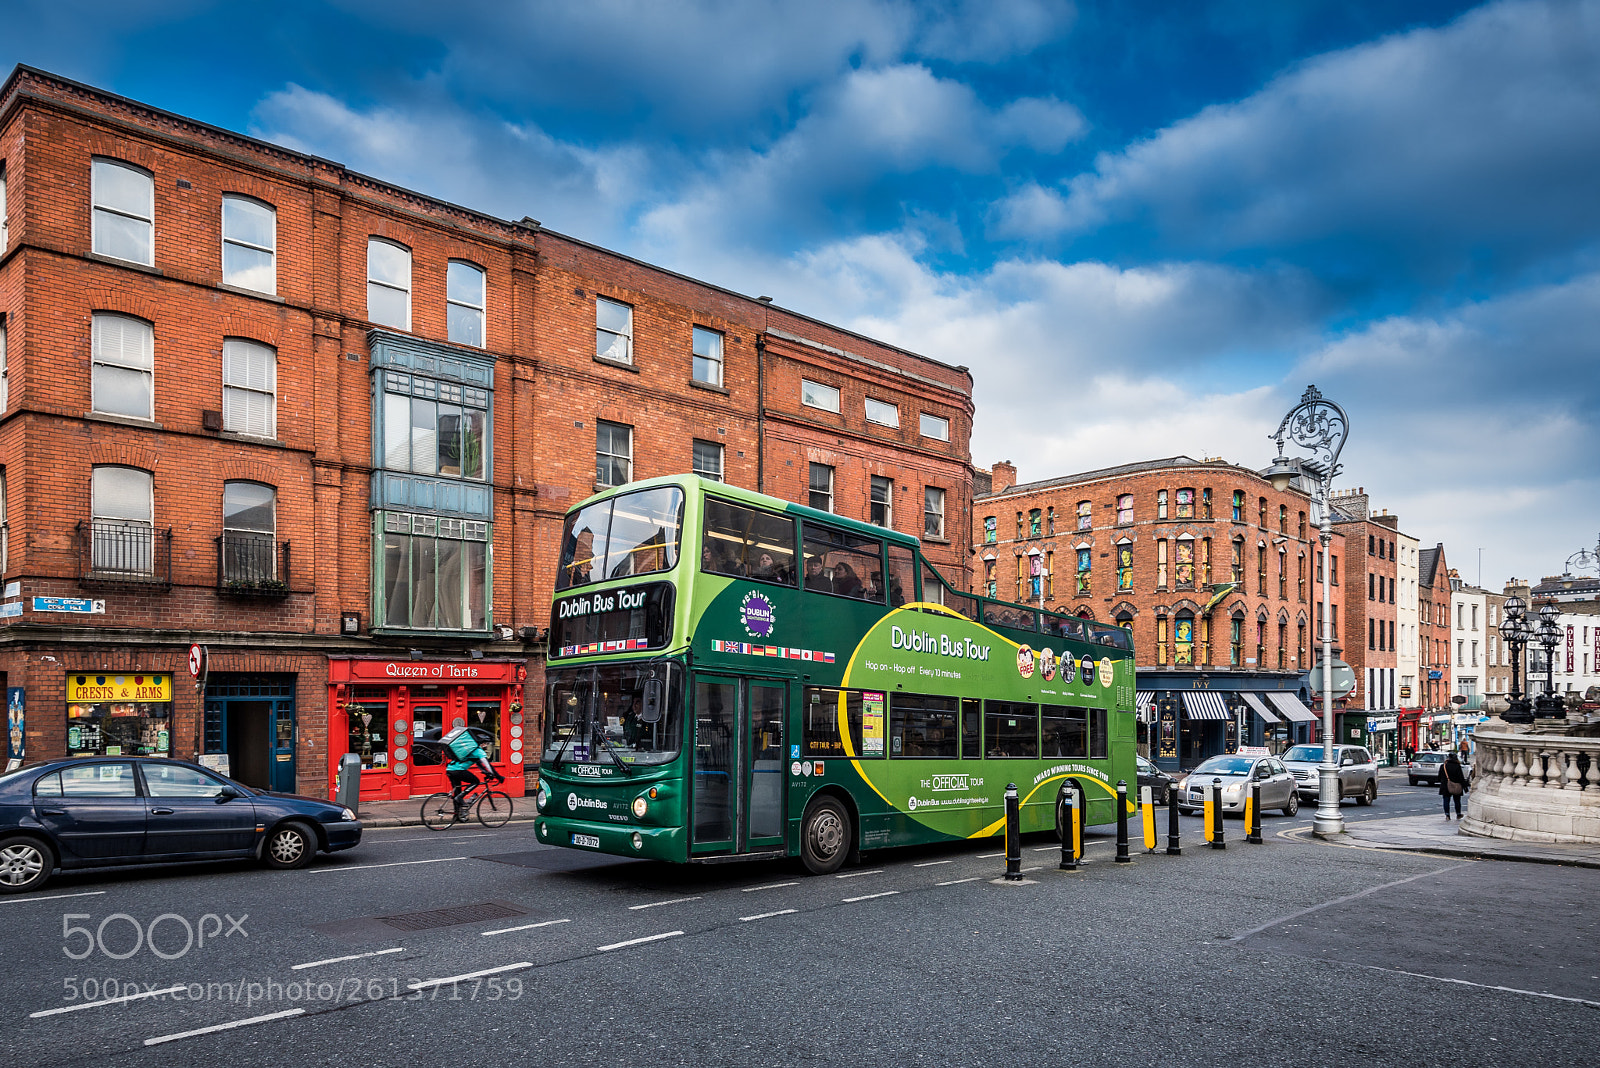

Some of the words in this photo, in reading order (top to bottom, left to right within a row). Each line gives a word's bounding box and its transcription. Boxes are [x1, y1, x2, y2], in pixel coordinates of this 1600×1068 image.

[559, 597, 591, 618] Dublin
[593, 594, 614, 613] Bus
[617, 590, 646, 609] Tour
[747, 607, 770, 618] DUBLIN
[891, 625, 938, 654] Dublin
[940, 634, 963, 657] Bus
[964, 637, 990, 661] Tour
[385, 662, 428, 678] Queen
[431, 664, 444, 678] of
[447, 663, 478, 678] Tarts
[865, 660, 878, 672] Hop
[879, 663, 888, 671] on
[893, 663, 905, 674] Hop
[906, 665, 916, 674] off
[919, 666, 934, 678] Every
[941, 669, 961, 679] minutes
[1019, 663, 1034, 677] FREE
[1192, 681, 1210, 689] IVY
[76, 686, 114, 699] CRESTS
[120, 688, 129, 697] &
[135, 686, 162, 699] ARMS
[1033, 770, 1051, 785] AWARD
[1051, 764, 1071, 775] WINNING
[1071, 763, 1086, 772] TOURS
[1086, 765, 1099, 777] SINCE
[920, 779, 931, 788] THE
[932, 776, 969, 789] OFFICIAL
[970, 777, 984, 786] TOUR
[577, 797, 595, 808] Dublin
[595, 799, 608, 809] Bus
[608, 814, 629, 822] VOLVO
